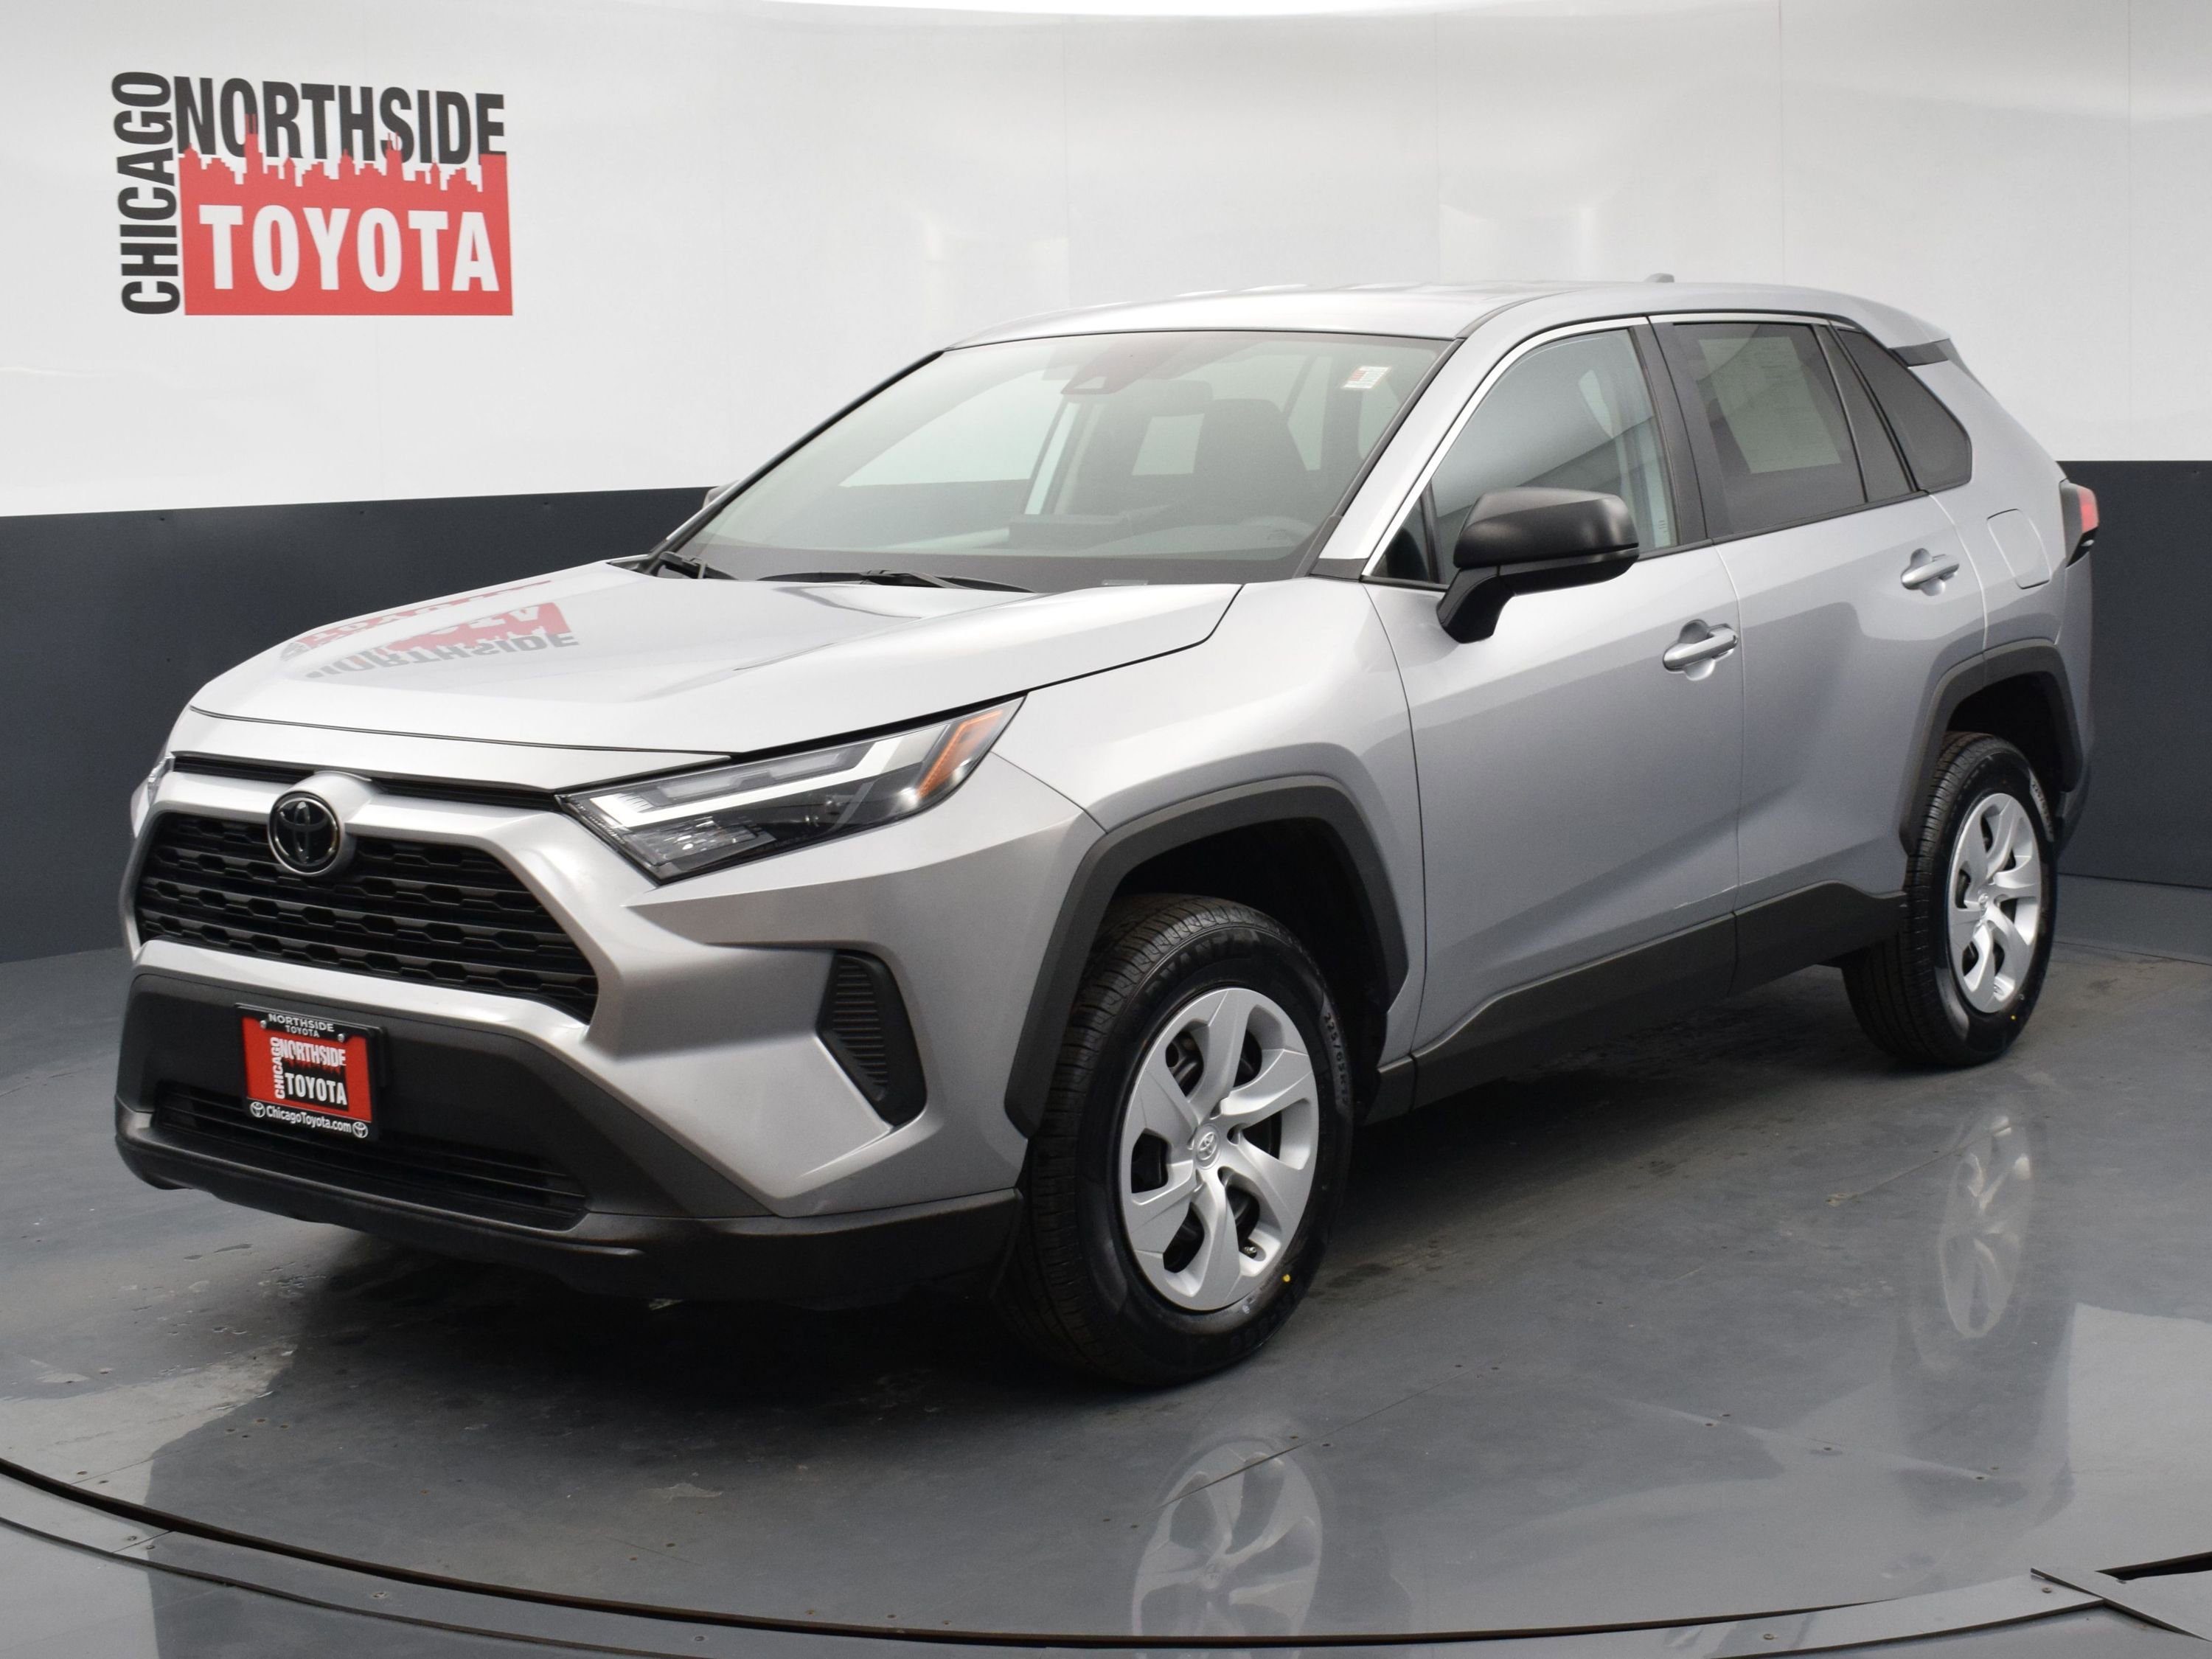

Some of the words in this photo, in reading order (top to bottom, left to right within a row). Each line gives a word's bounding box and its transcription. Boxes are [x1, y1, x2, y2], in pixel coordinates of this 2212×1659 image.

[173, 76, 507, 165] NORTHSIDE
[111, 72, 181, 315] CHICAGO
[198, 204, 500, 293] TOYOTA
[268, 1014, 335, 1032] NORTHSIDE
[285, 1025, 320, 1038] TOYOTA
[270, 1037, 285, 1099] CHICAGO
[280, 1038, 346, 1066] NORTHSIDE
[285, 1072, 347, 1105] TOYOTA
[266, 1106, 352, 1133] ChicagoToyota.com
